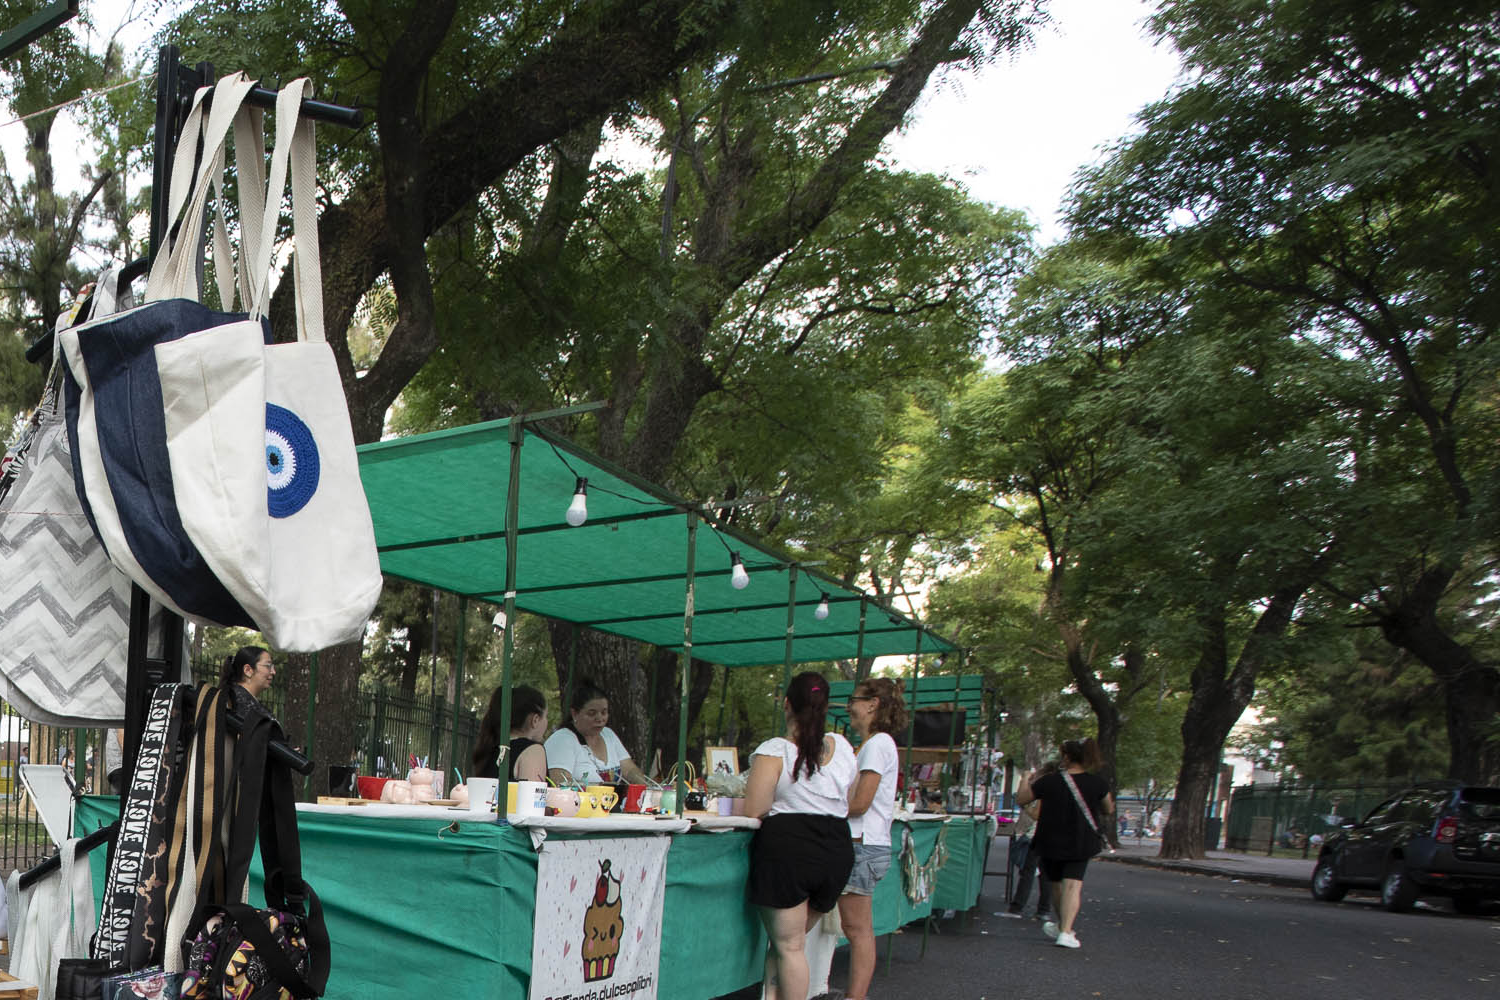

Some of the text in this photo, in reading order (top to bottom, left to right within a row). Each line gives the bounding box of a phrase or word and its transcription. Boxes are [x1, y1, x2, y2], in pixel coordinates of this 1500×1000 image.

[113, 699, 169, 952] LOVE LOVE LOVE LOVE LOVE
